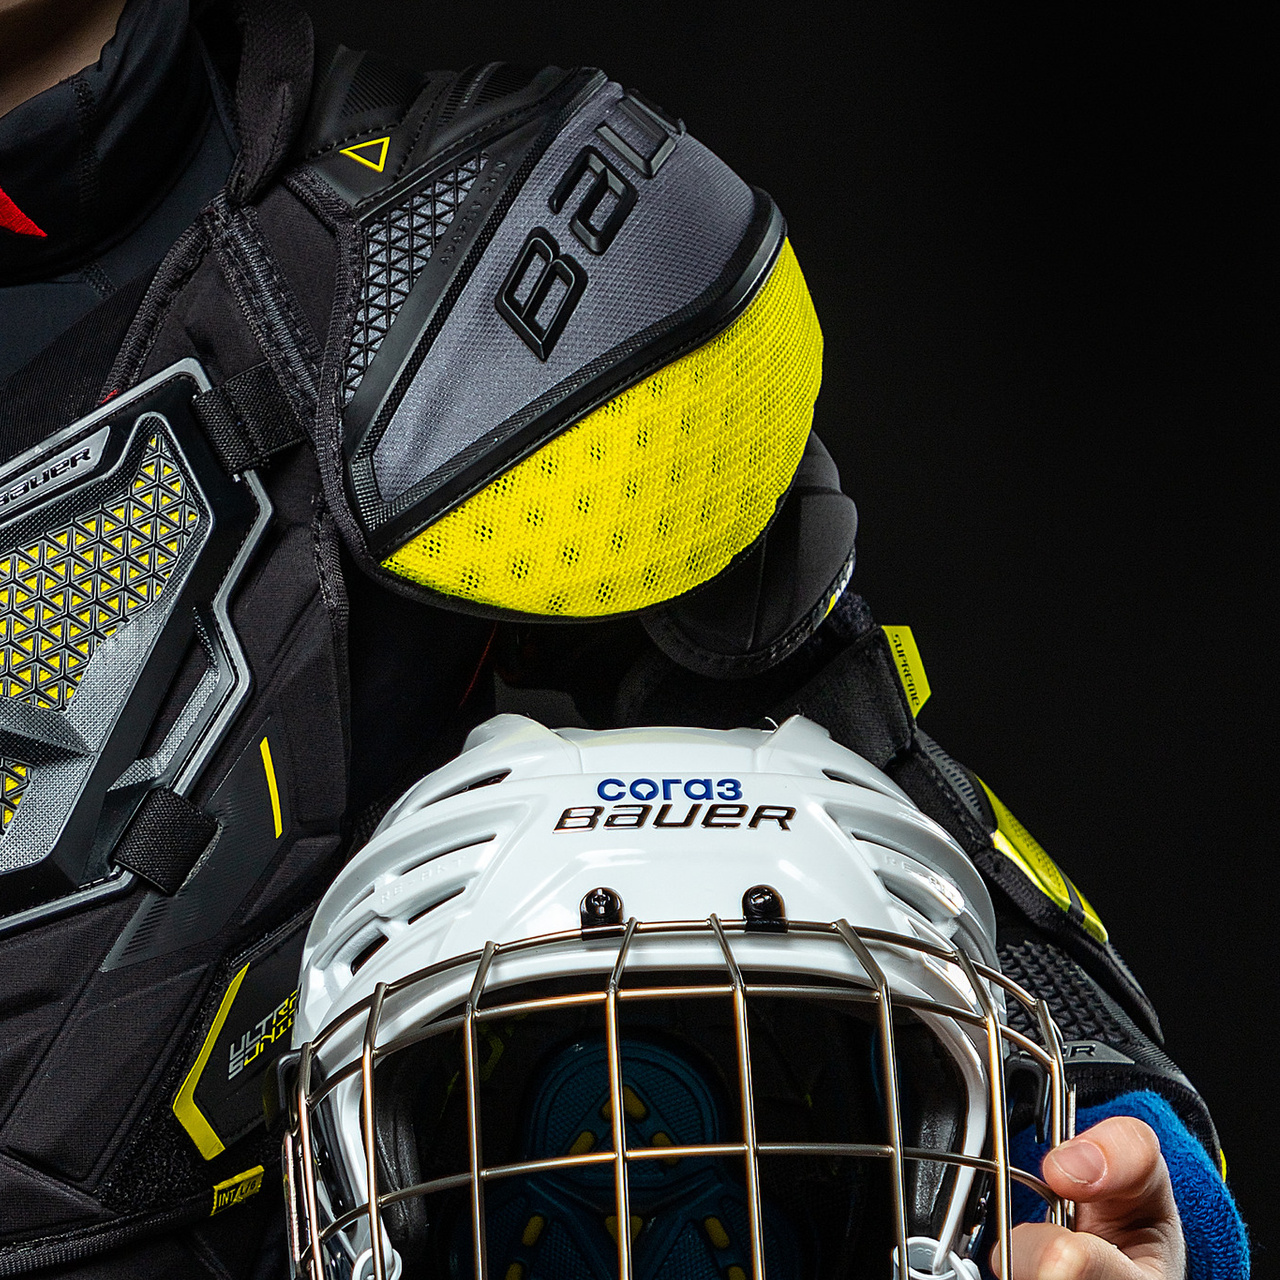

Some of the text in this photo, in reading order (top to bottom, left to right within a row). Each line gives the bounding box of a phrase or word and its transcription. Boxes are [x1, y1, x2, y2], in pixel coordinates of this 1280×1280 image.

[495, 89, 685, 361] BAU
[892, 633, 921, 707] SUPREME
[552, 803, 797, 834] BAUER
